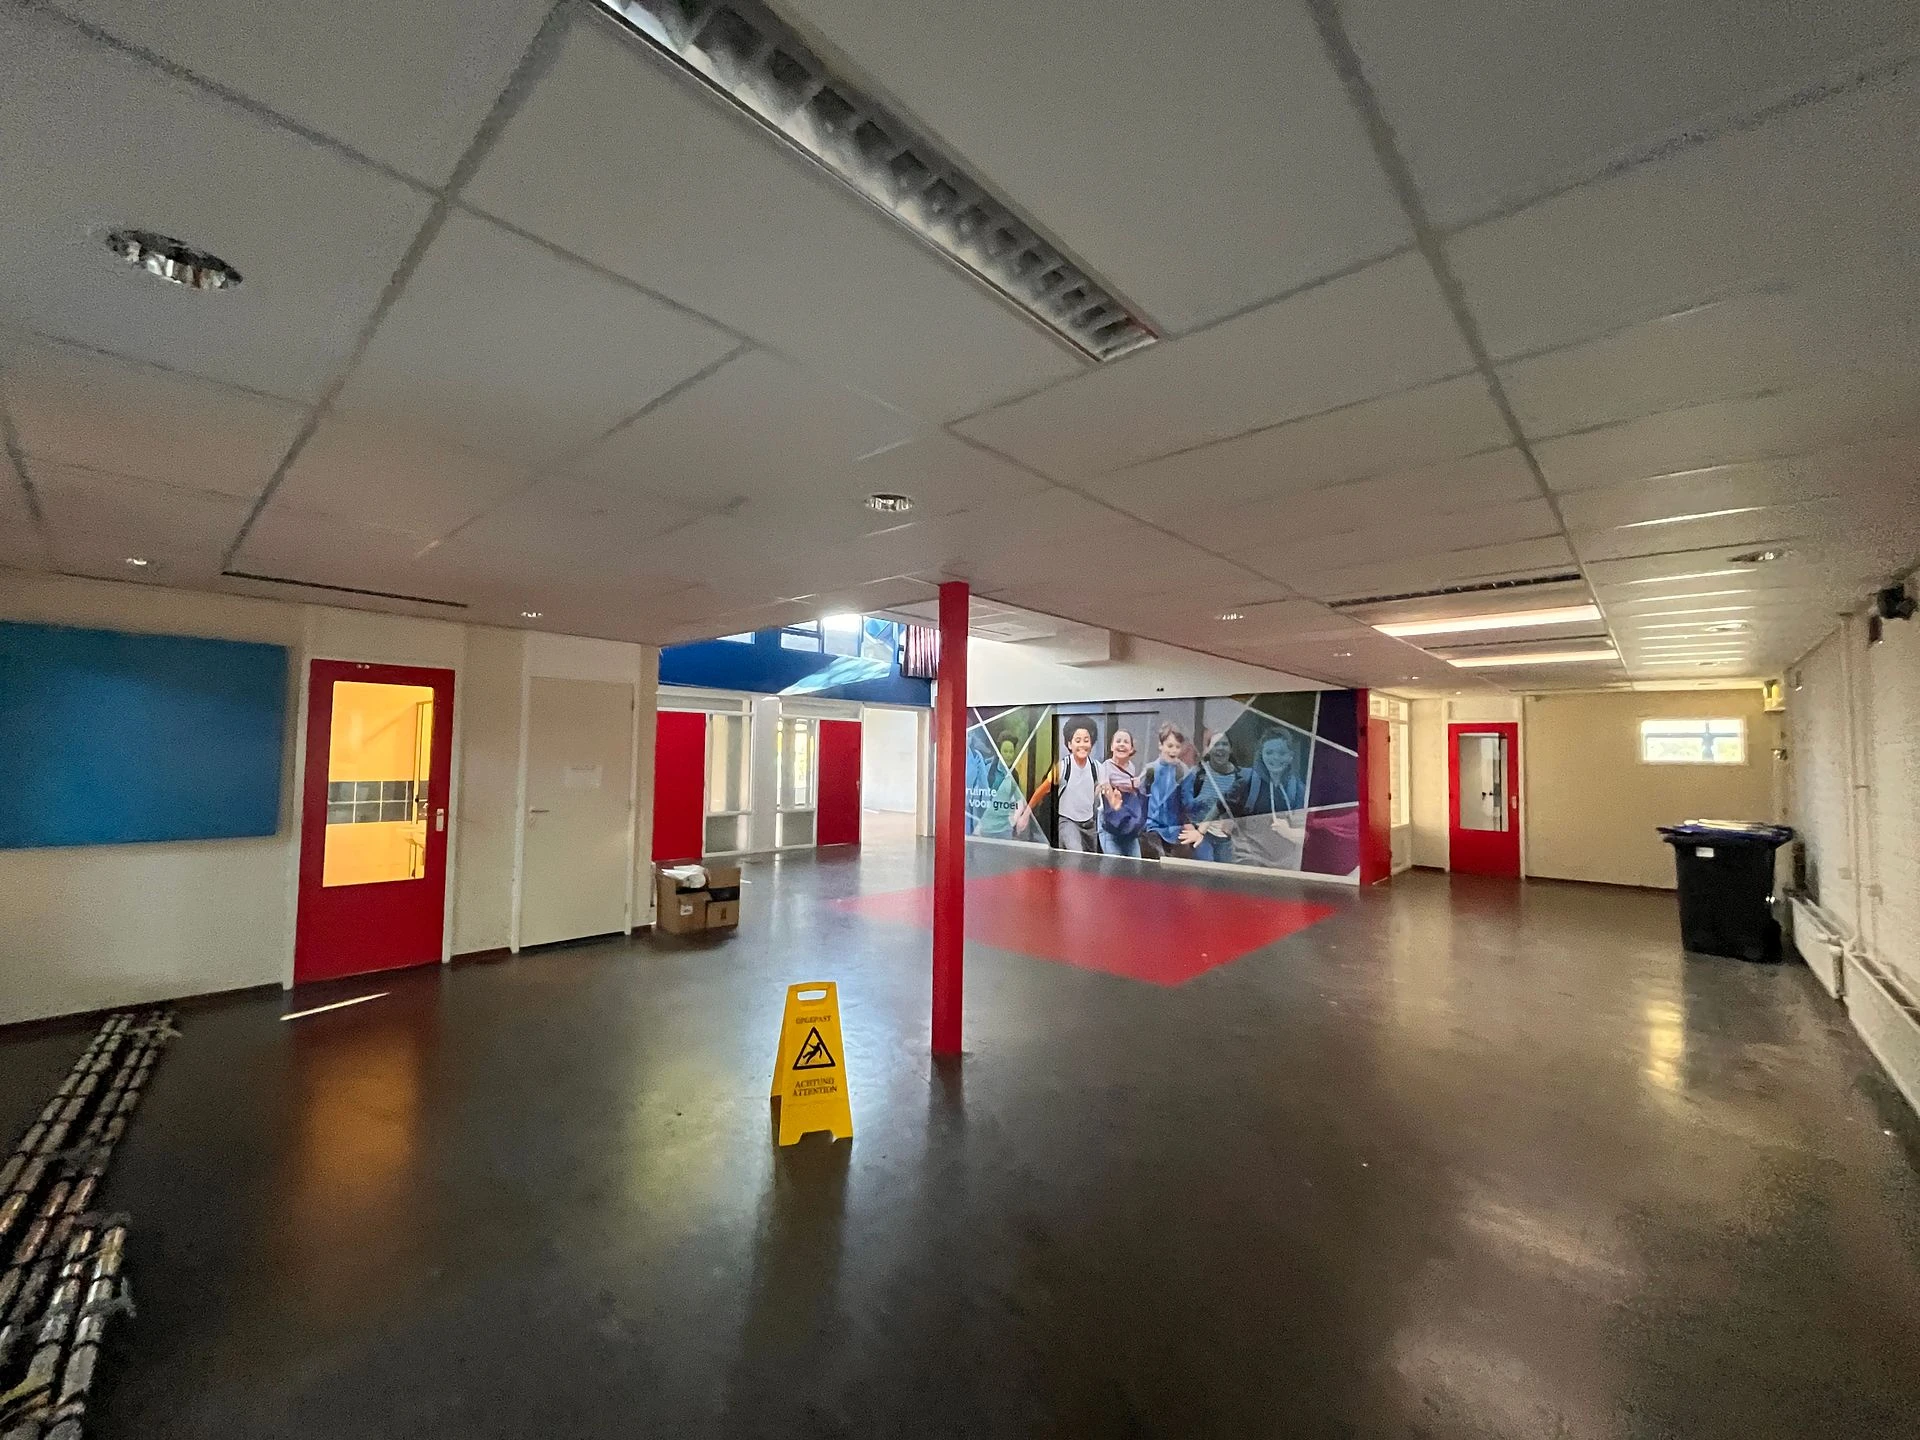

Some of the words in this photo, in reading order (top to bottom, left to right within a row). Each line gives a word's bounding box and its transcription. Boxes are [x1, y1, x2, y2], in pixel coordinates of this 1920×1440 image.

[993, 800, 1018, 811] groei
[795, 1077, 834, 1088] ACHTUNG
[792, 1086, 837, 1096] ATTENTION
